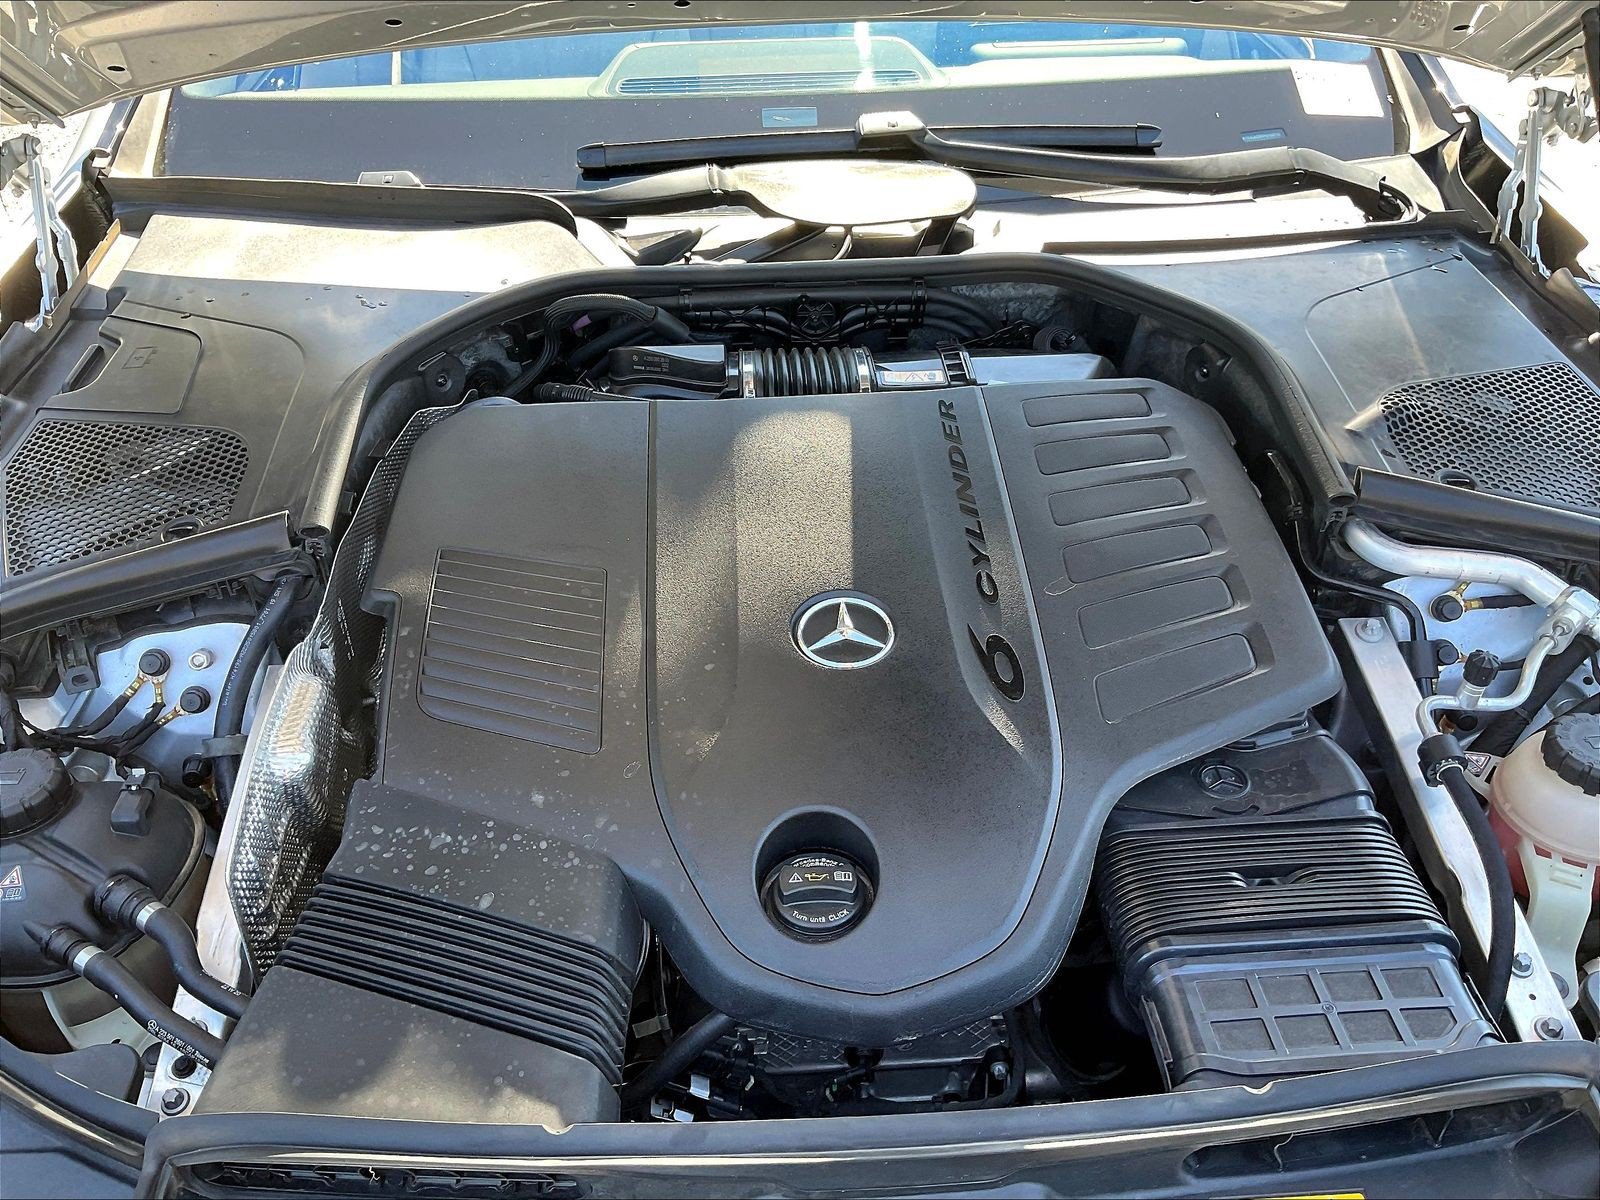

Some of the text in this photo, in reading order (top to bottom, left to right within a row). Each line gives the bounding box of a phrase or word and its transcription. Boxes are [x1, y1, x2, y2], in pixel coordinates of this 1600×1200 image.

[938, 398, 1025, 702] 6 CYLINDER
[792, 910, 808, 921] Turn
[828, 908, 850, 922] CLICK
